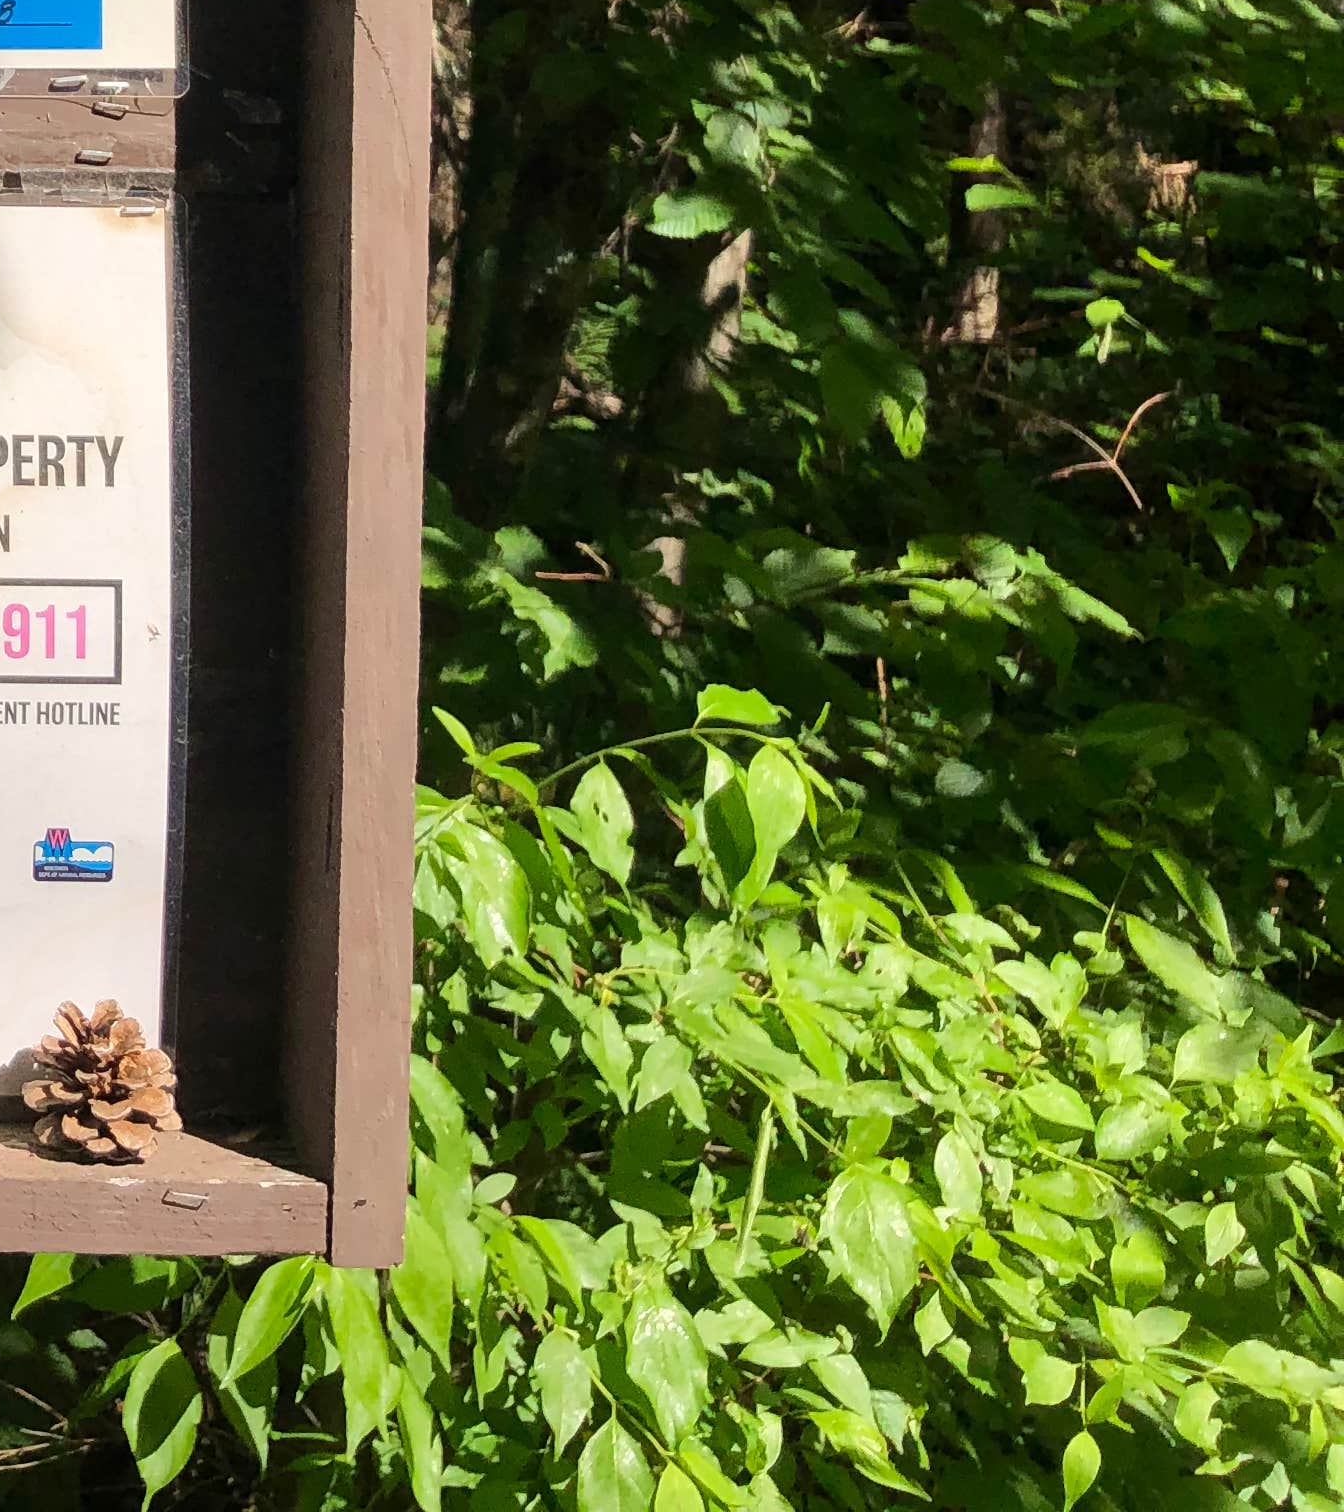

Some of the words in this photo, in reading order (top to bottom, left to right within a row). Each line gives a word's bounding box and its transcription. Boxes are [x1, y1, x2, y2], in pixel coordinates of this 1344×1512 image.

[3, 604, 86, 659] 911
[37, 702, 120, 725] HOTLINE
[48, 828, 68, 850] W
